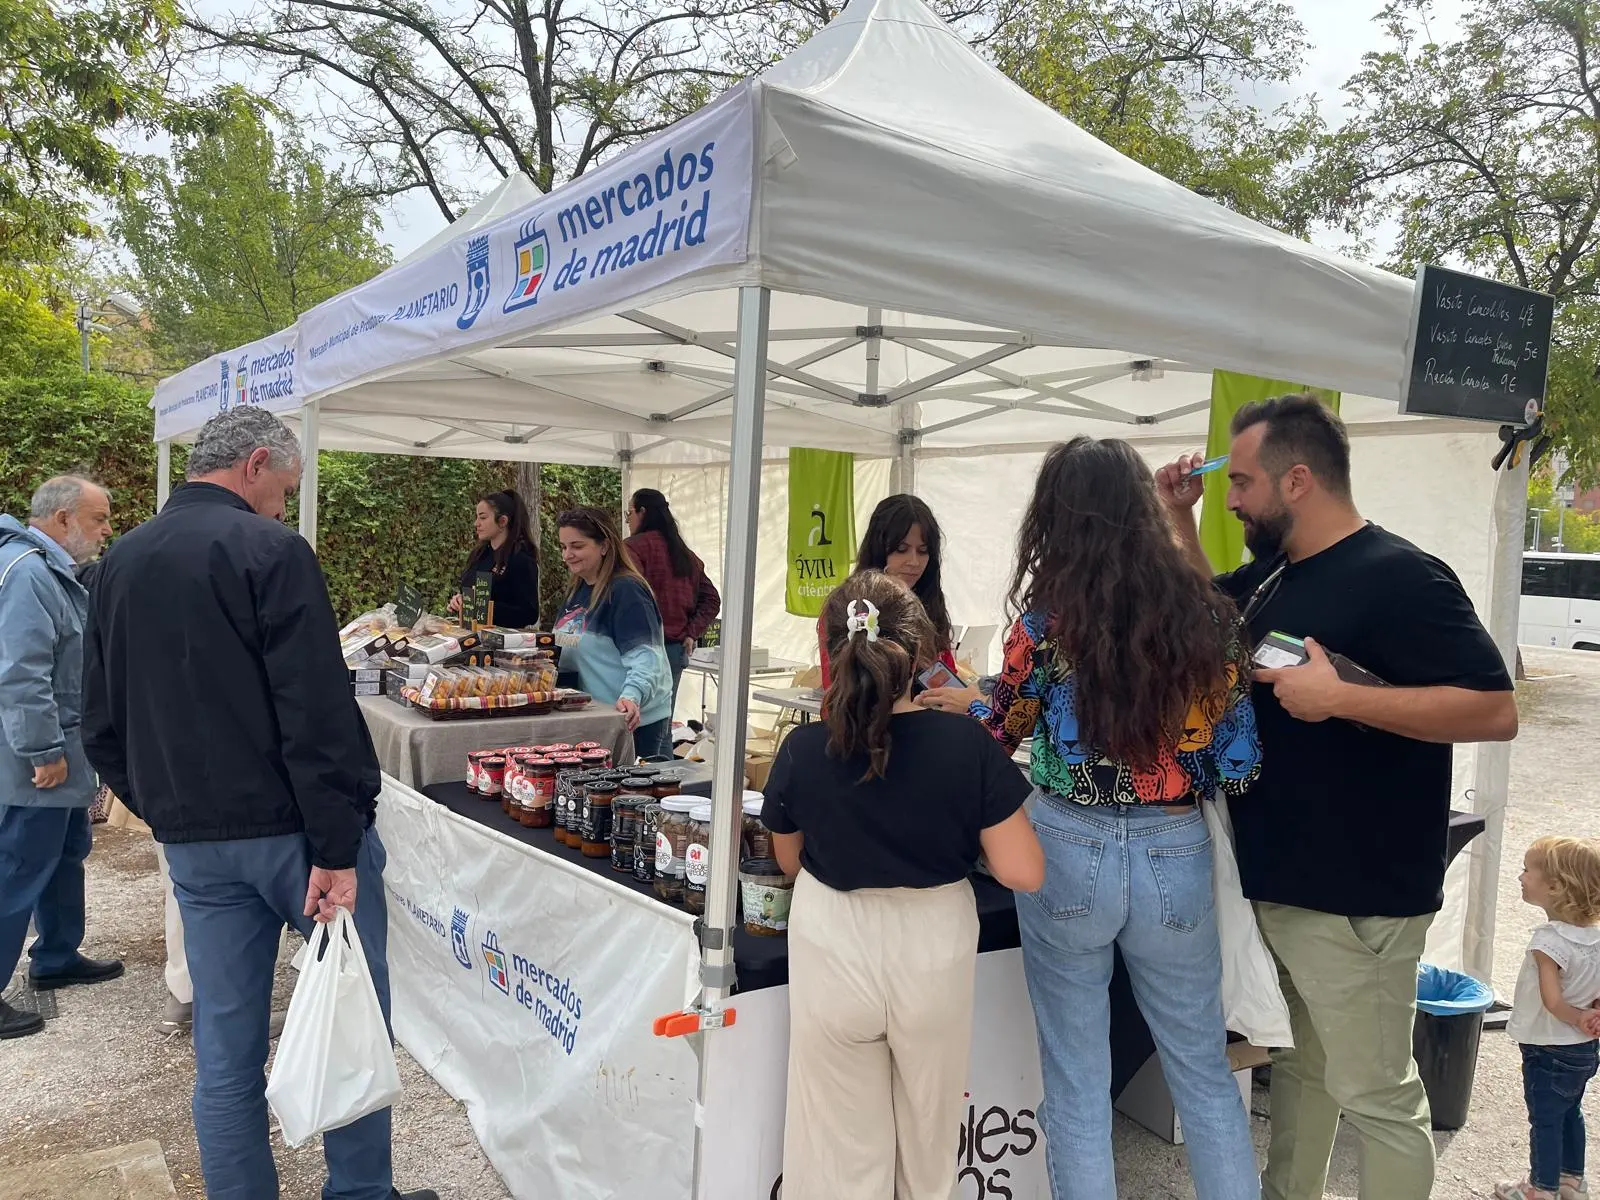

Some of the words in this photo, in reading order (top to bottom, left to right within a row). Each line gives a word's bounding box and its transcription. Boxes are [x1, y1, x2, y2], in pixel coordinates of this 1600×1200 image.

[556, 141, 715, 243] mercados
[552, 247, 587, 292] de
[590, 191, 711, 281] madrid
[387, 282, 458, 321] PLANETARIO
[1436, 282, 1463, 310] Vasito
[250, 344, 295, 377] mercados
[1430, 322, 1458, 344] Vasito
[1523, 341, 1538, 361] 5€
[250, 380, 259, 404] de
[260, 370, 294, 402] madrid
[1500, 372, 1518, 394] 9€
[512, 952, 582, 1020] mercados
[515, 978, 533, 1010] de
[533, 1000, 579, 1056] madrid
